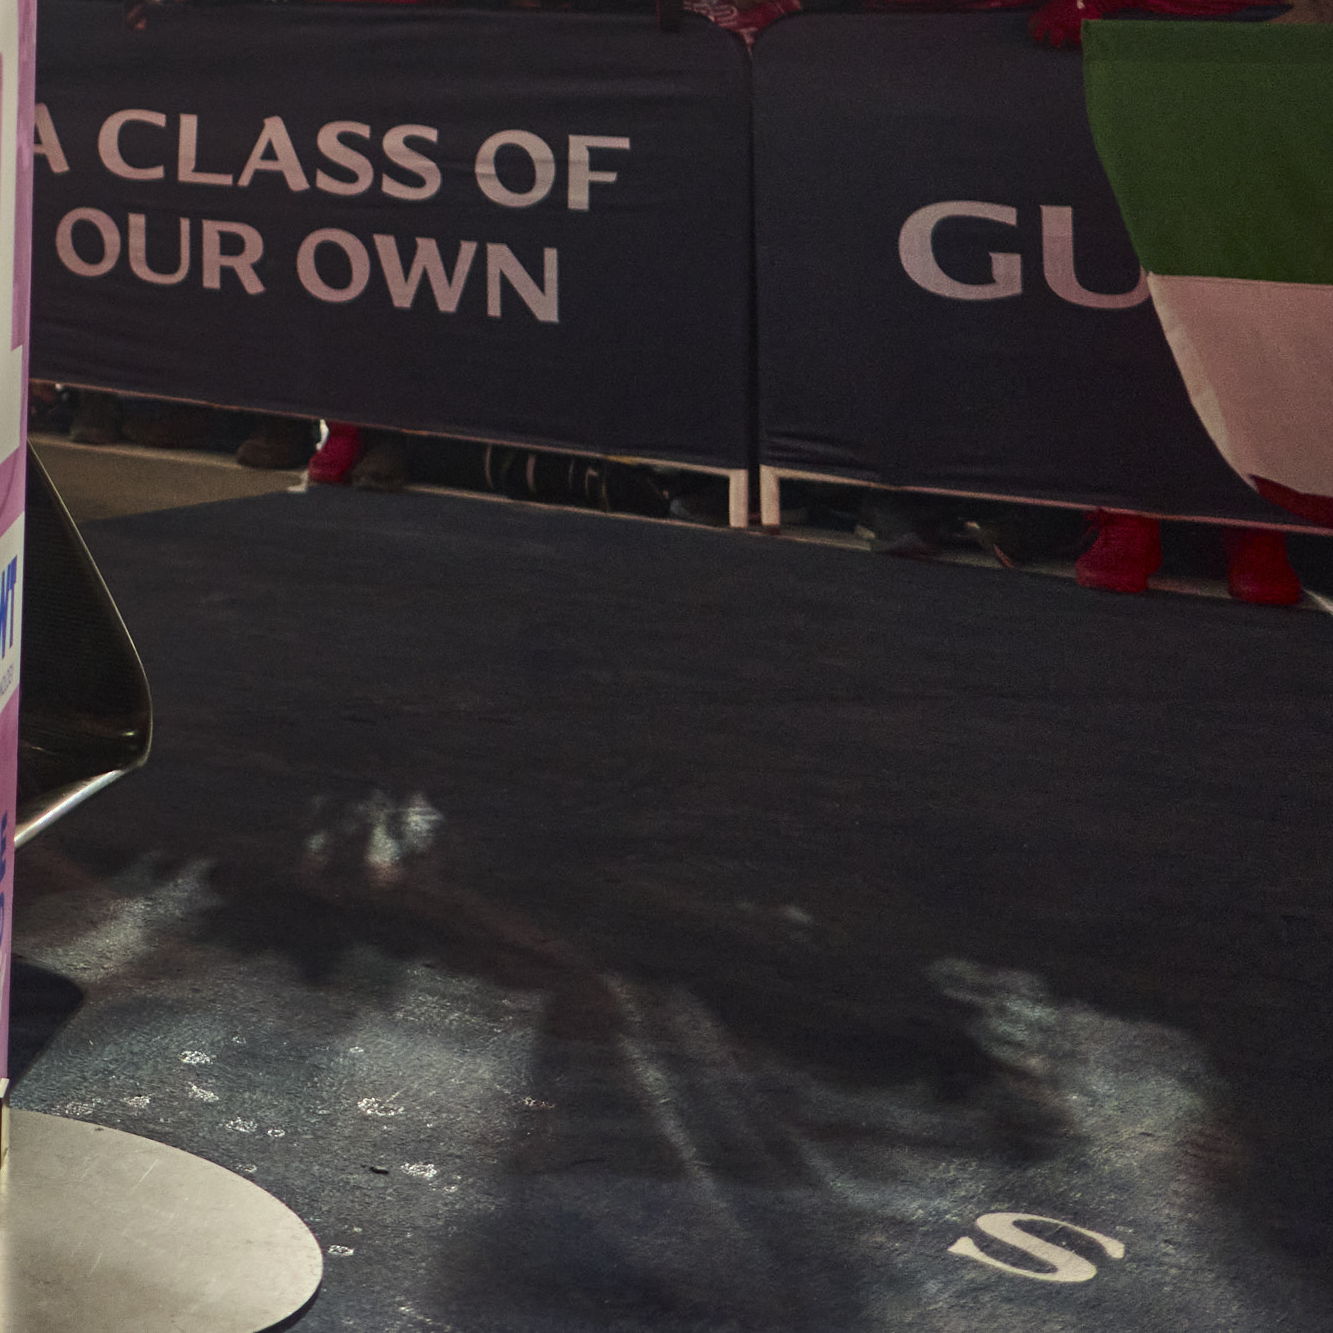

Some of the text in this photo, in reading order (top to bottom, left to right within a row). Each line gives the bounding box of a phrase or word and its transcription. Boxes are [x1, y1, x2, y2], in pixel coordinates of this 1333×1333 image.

[97, 108, 442, 202] CLASS
[475, 129, 631, 211] OF
[55, 206, 560, 324] OUR OWN
[897, 200, 1151, 309] GU
